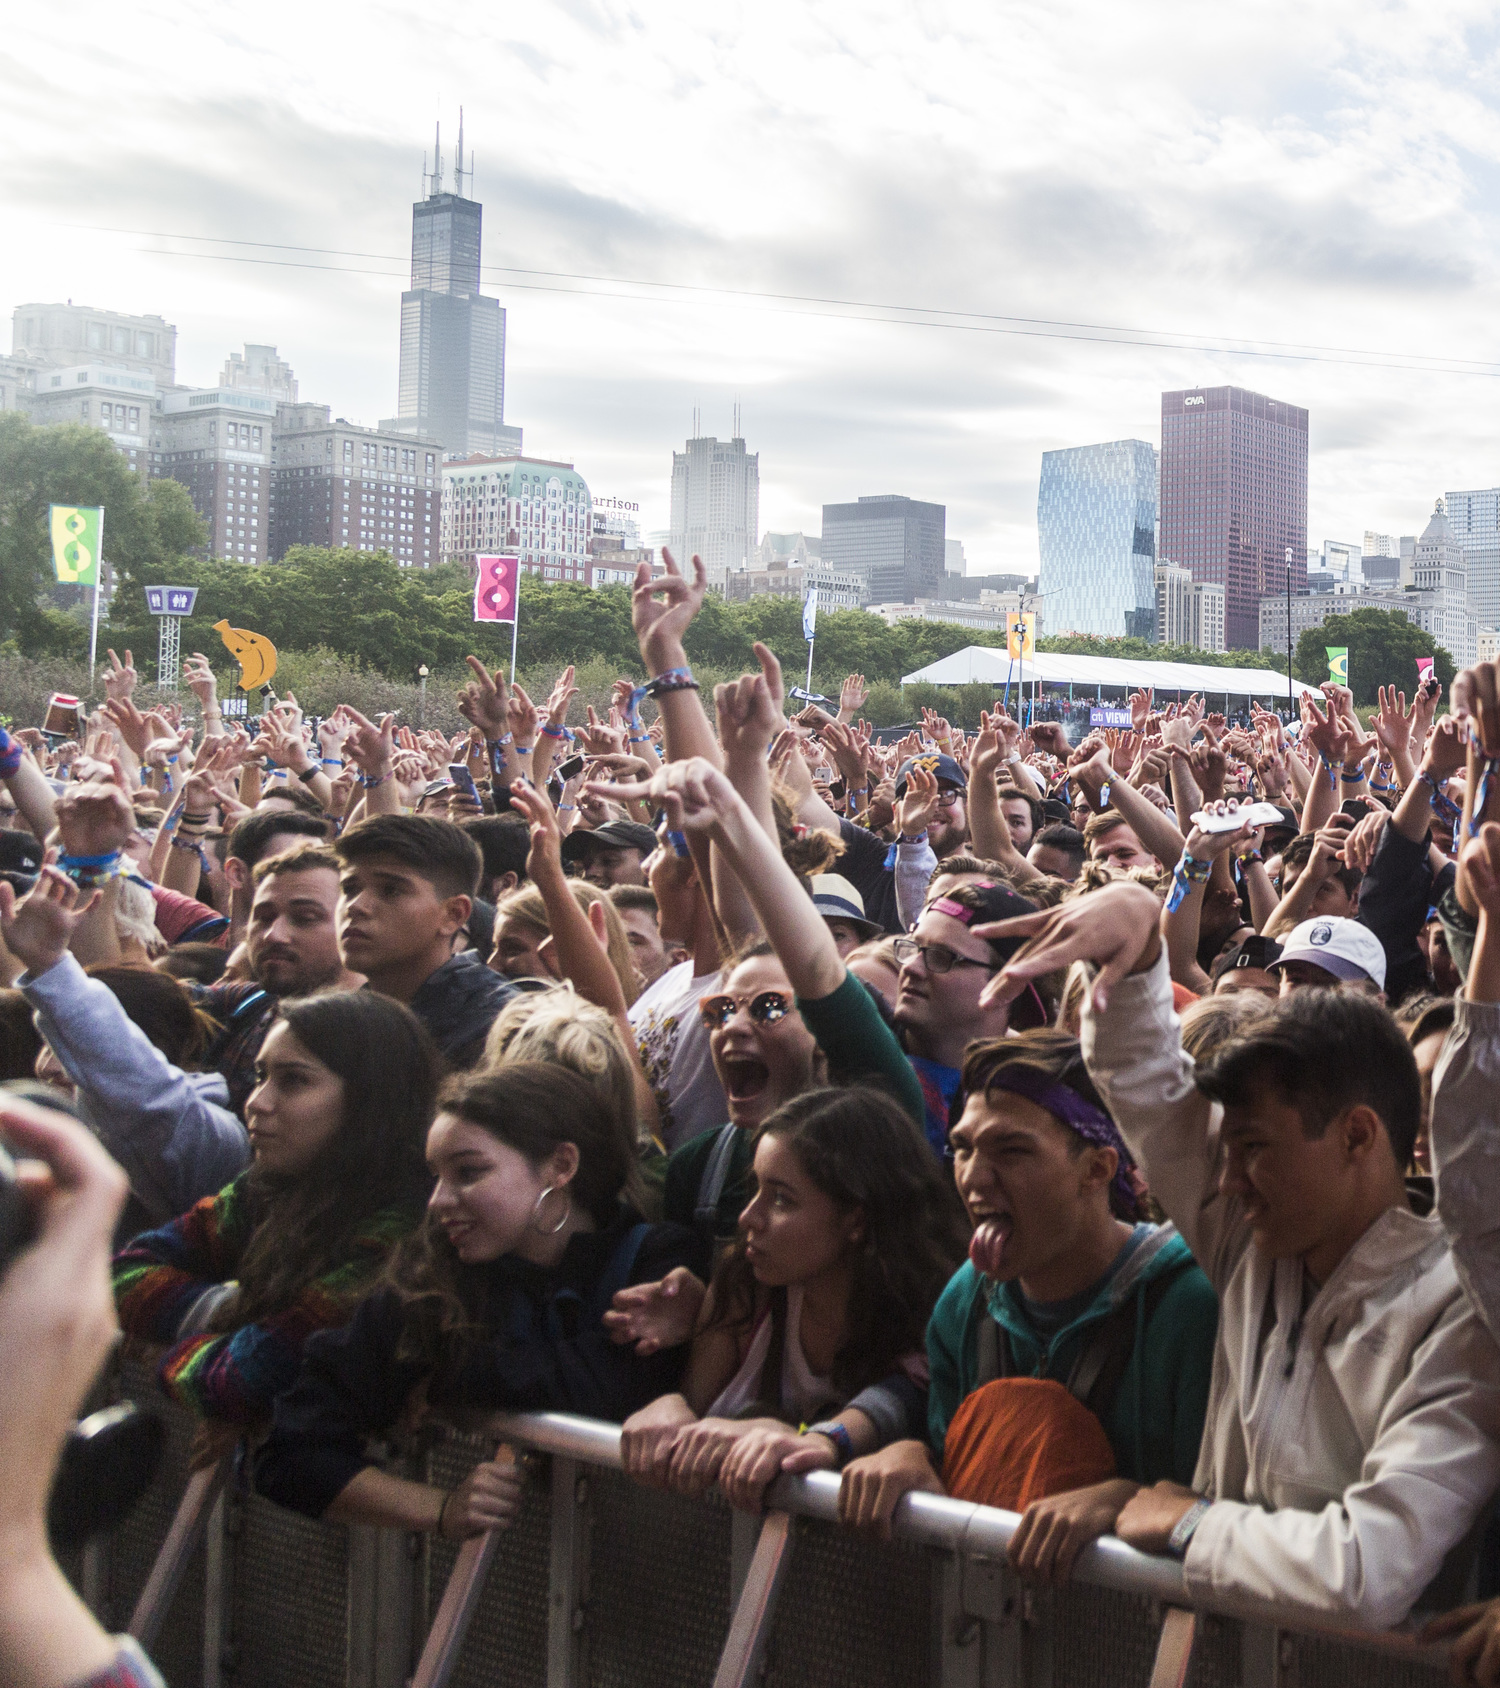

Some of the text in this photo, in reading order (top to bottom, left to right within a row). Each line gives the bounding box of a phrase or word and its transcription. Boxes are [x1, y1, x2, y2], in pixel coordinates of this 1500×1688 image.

[1184, 396, 1205, 406] CNA
[592, 496, 639, 511] arrison
[604, 510, 631, 520] HOTEL
[1105, 711, 1132, 725] VIEWI
